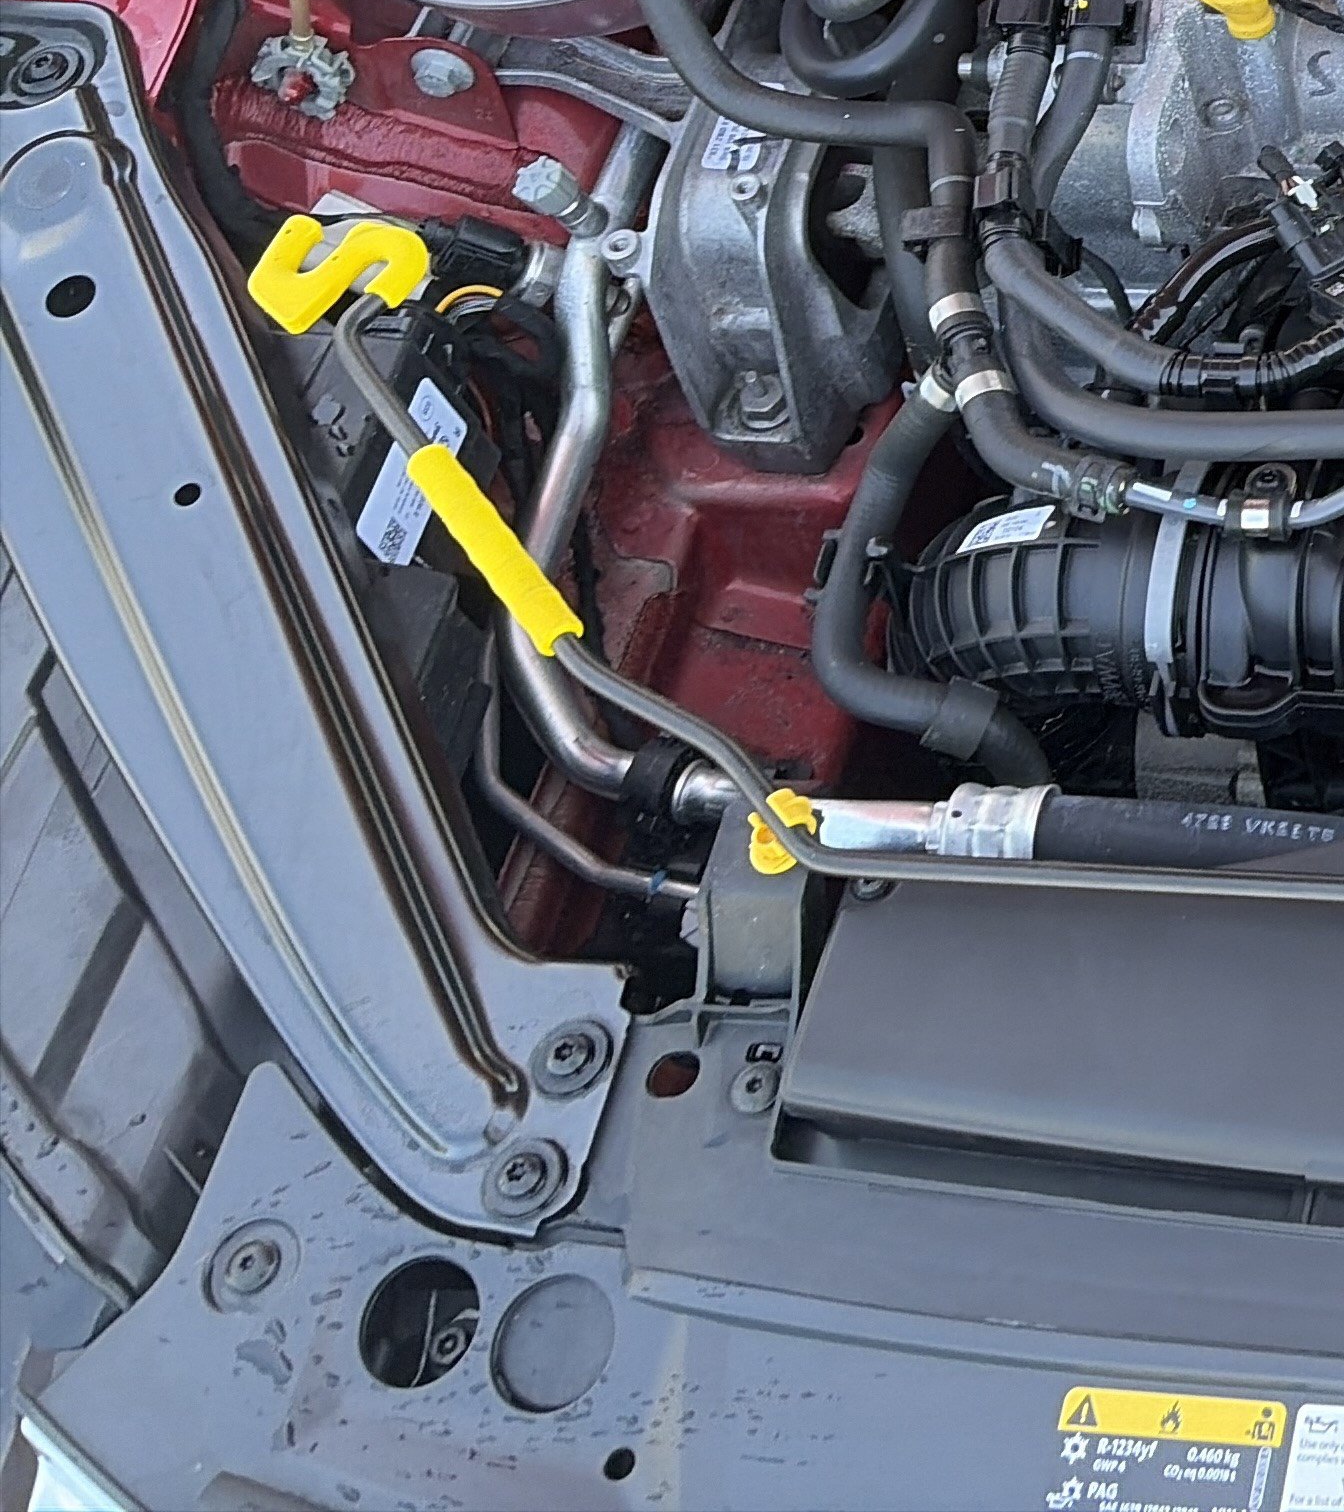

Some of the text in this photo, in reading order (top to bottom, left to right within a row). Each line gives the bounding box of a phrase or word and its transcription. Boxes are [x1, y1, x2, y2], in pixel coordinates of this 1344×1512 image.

[1096, 1437, 1158, 1463] R-1234yf
[1223, 1451, 1241, 1469] kg
[1319, 1441, 1340, 1453] only
[1086, 1482, 1119, 1501] PAG
